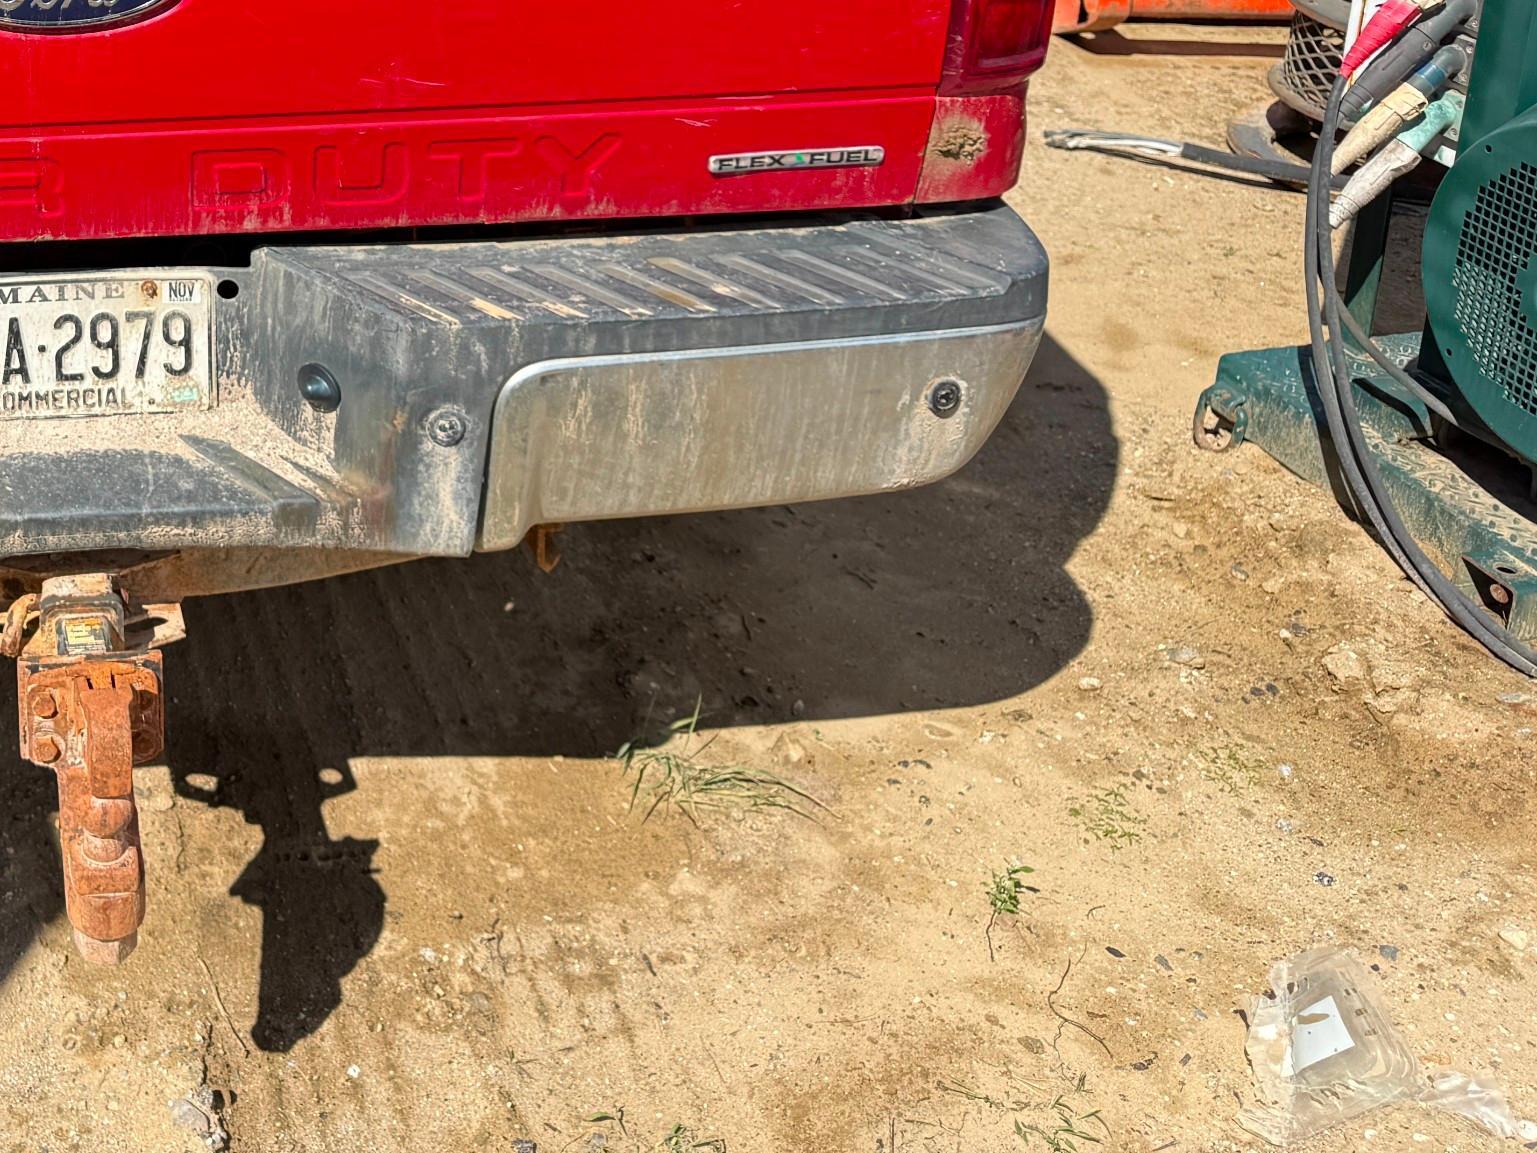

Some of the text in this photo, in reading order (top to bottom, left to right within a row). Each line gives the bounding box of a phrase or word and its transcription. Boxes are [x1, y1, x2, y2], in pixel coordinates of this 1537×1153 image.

[718, 148, 877, 171] FLEX FUEL
[189, 134, 623, 211] DUTY
[169, 281, 195, 298] NOV
